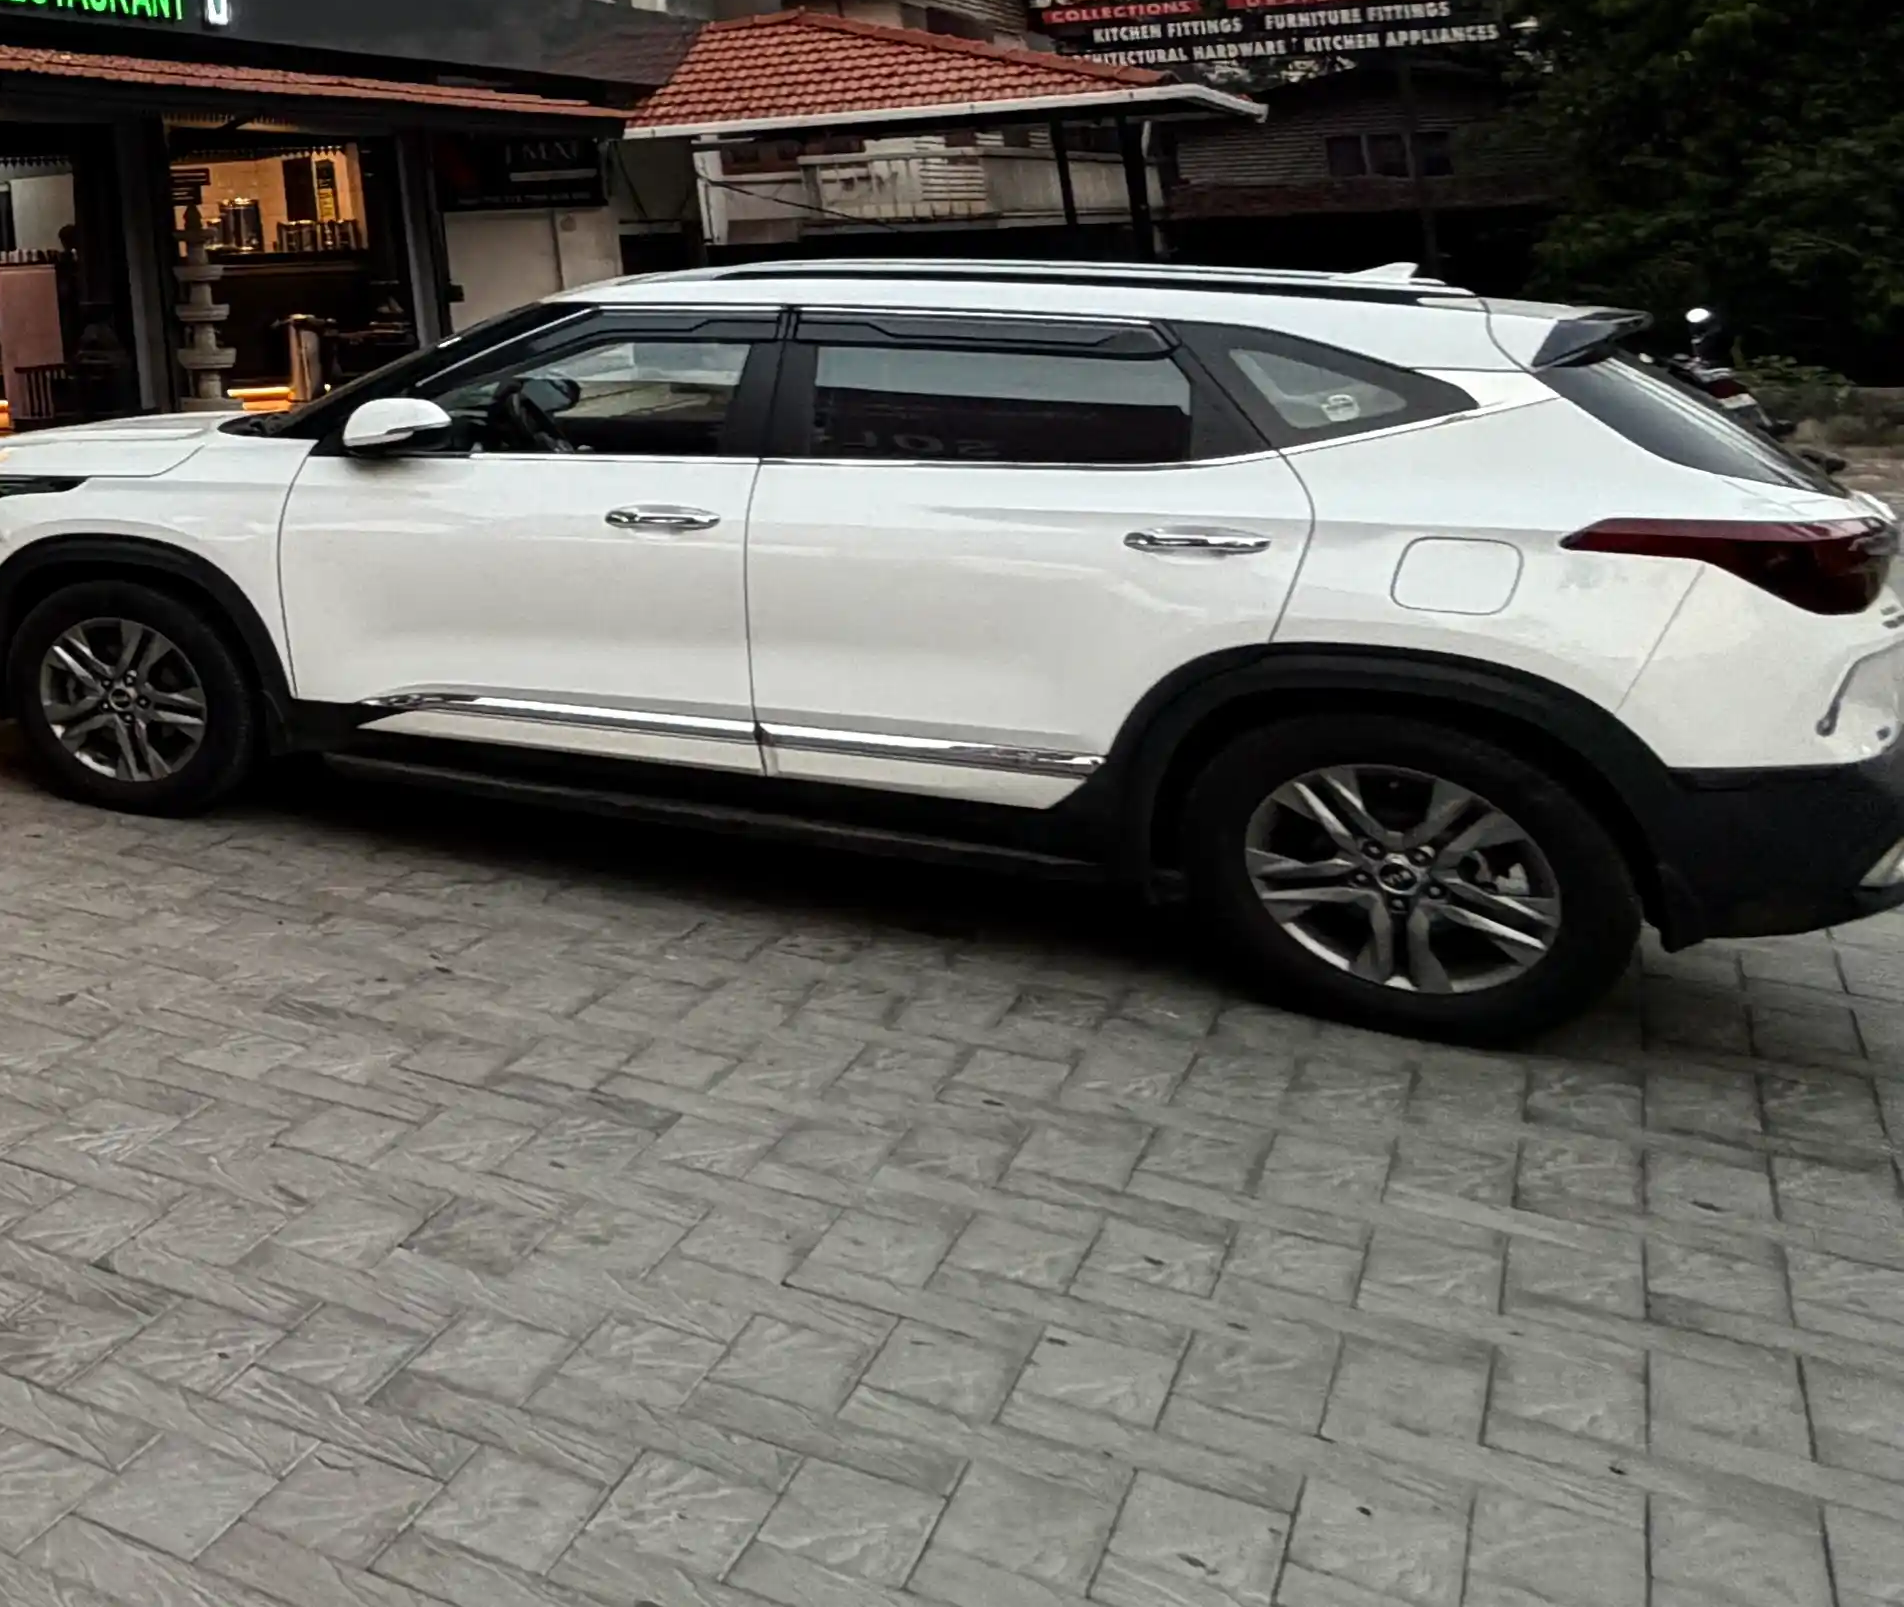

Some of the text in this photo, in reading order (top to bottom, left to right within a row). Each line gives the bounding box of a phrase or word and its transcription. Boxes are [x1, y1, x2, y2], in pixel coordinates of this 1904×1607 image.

[1050, 1, 1191, 24] COLLECTIONS
[1093, 1, 1451, 43] KITCHEN FITTINGS FURNITURE FITTINGS
[1194, 39, 1286, 62] HARDWARE
[1304, 32, 1380, 53] KITCHEN
[1386, 24, 1500, 48] APPLIANCES
